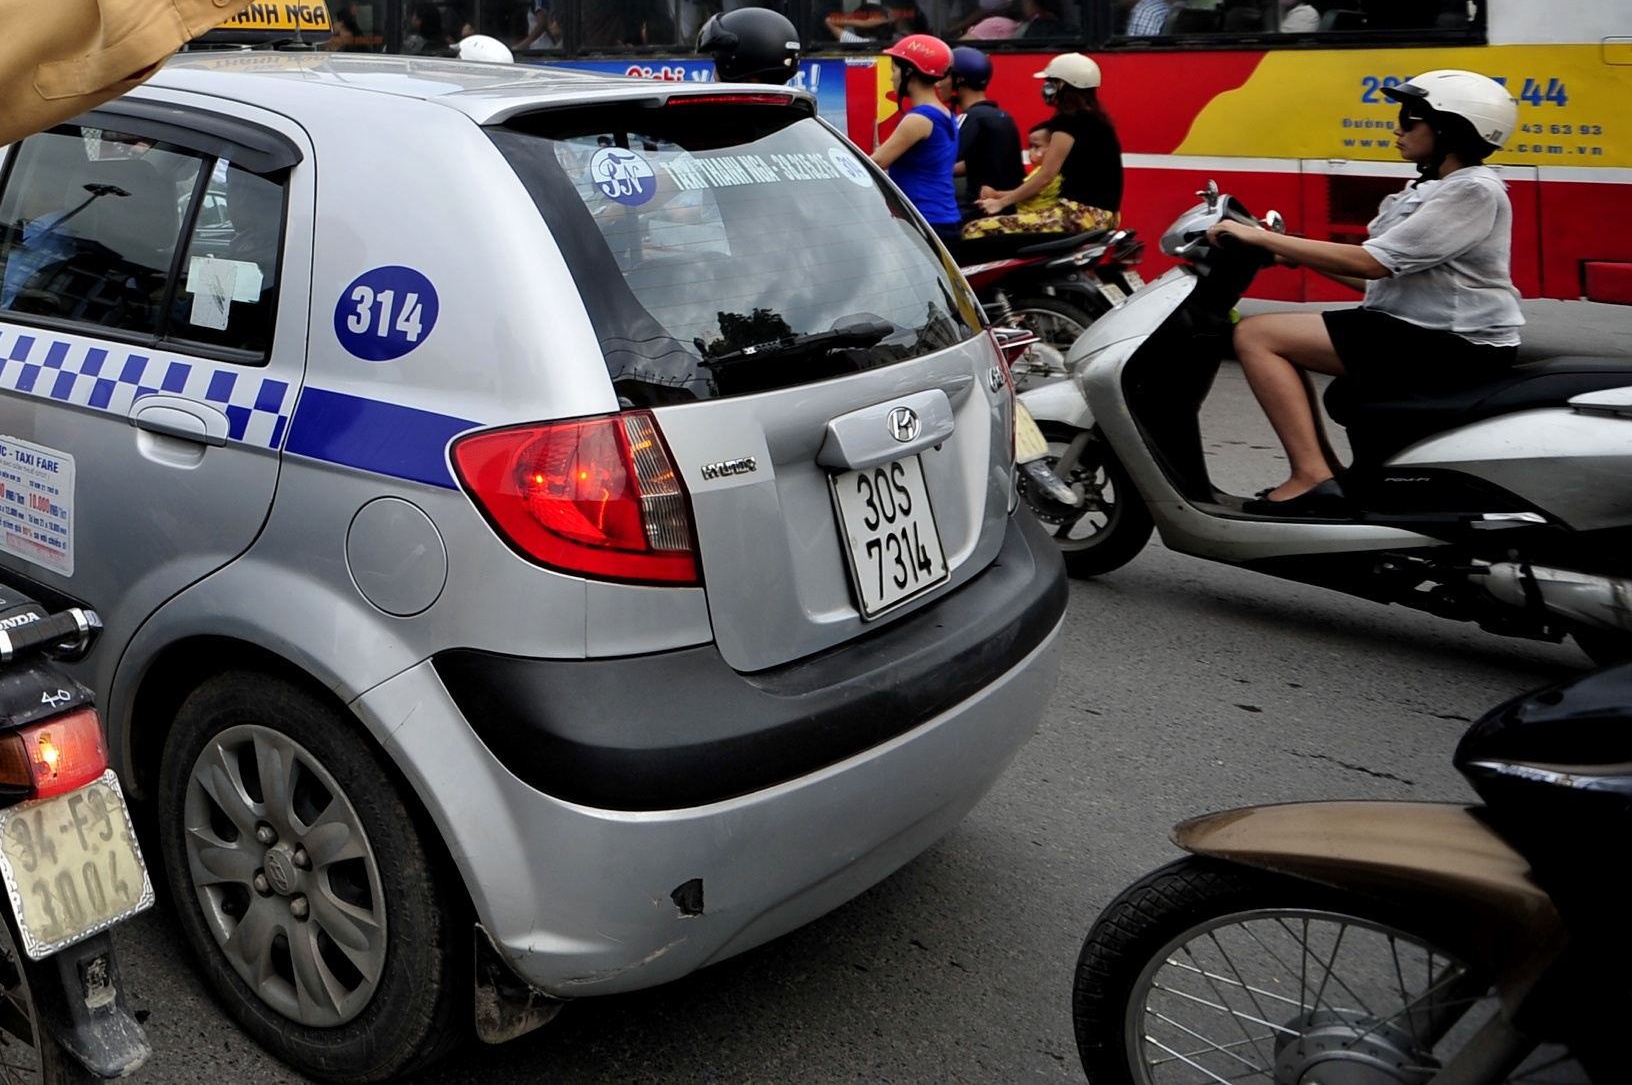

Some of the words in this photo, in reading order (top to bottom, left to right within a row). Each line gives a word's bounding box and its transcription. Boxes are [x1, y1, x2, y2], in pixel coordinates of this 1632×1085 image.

[285, 4, 326, 26] NGA
[1550, 124, 1572, 136] 63
[1579, 125, 1602, 136] 93
[347, 285, 422, 342] 314
[15, 450, 35, 465] TAXI
[36, 457, 59, 474] FARE
[29, 493, 50, 514] 10.000
[857, 462, 912, 531] 30S
[866, 520, 932, 601] 7314
